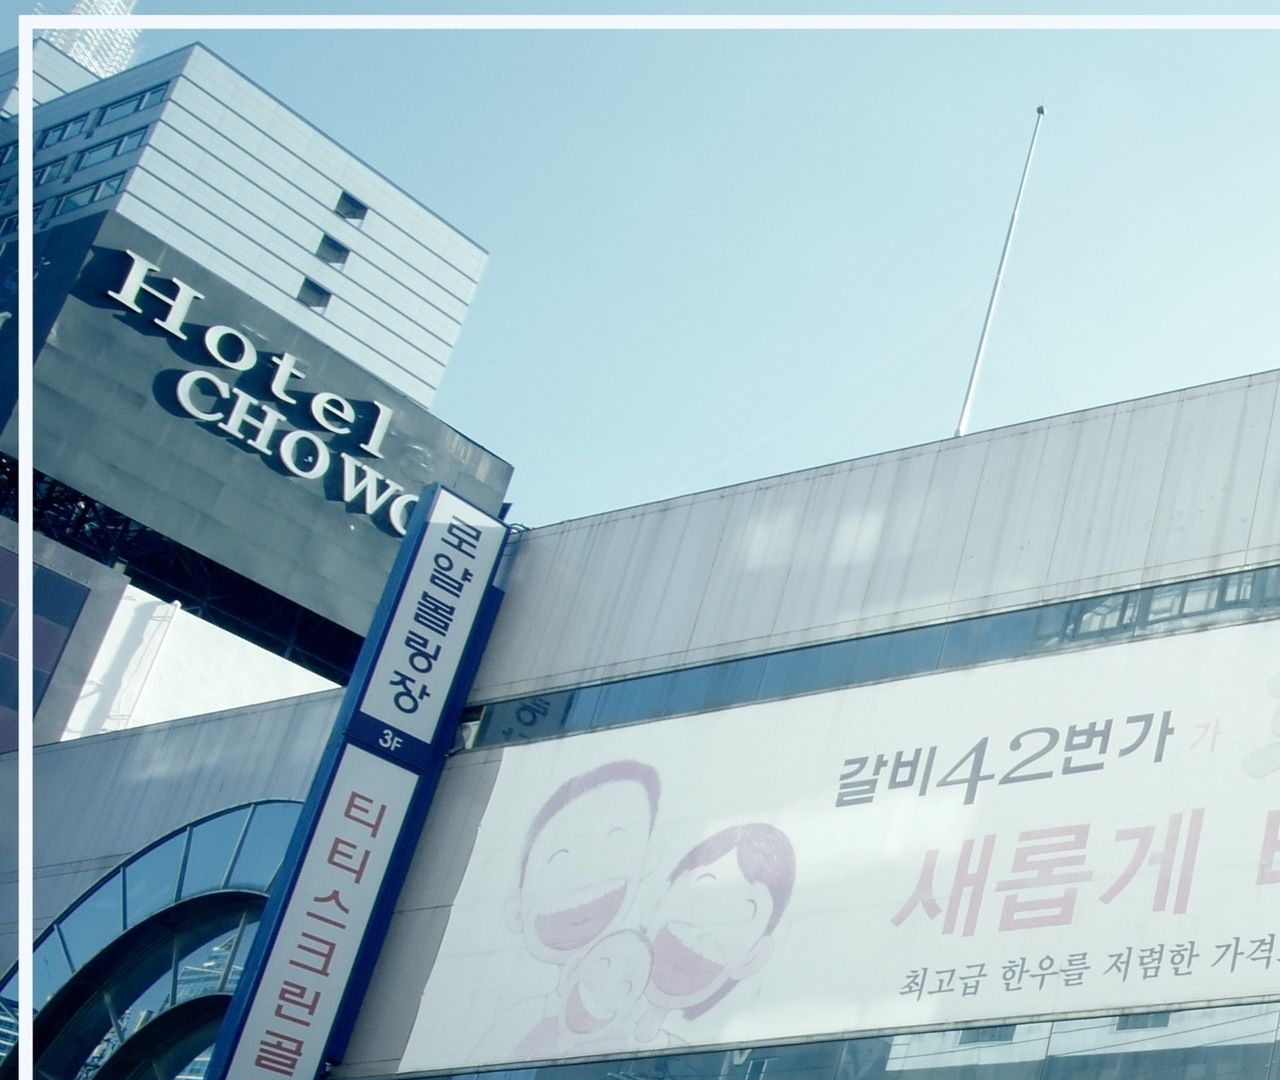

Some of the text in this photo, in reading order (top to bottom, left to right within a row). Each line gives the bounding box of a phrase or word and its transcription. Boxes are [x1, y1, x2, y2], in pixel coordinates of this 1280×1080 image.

[107, 249, 393, 459] Hotel
[389, 515, 483, 715] 로얄볼링장
[378, 729, 403, 751] 3F
[835, 710, 1175, 806] 갈비42번가
[1189, 718, 1224, 753] 가
[890, 807, 1205, 938] 새롭게
[899, 961, 988, 1003] 최고급
[1001, 951, 1091, 993] 한우를
[1103, 940, 1200, 983] 저렴한
